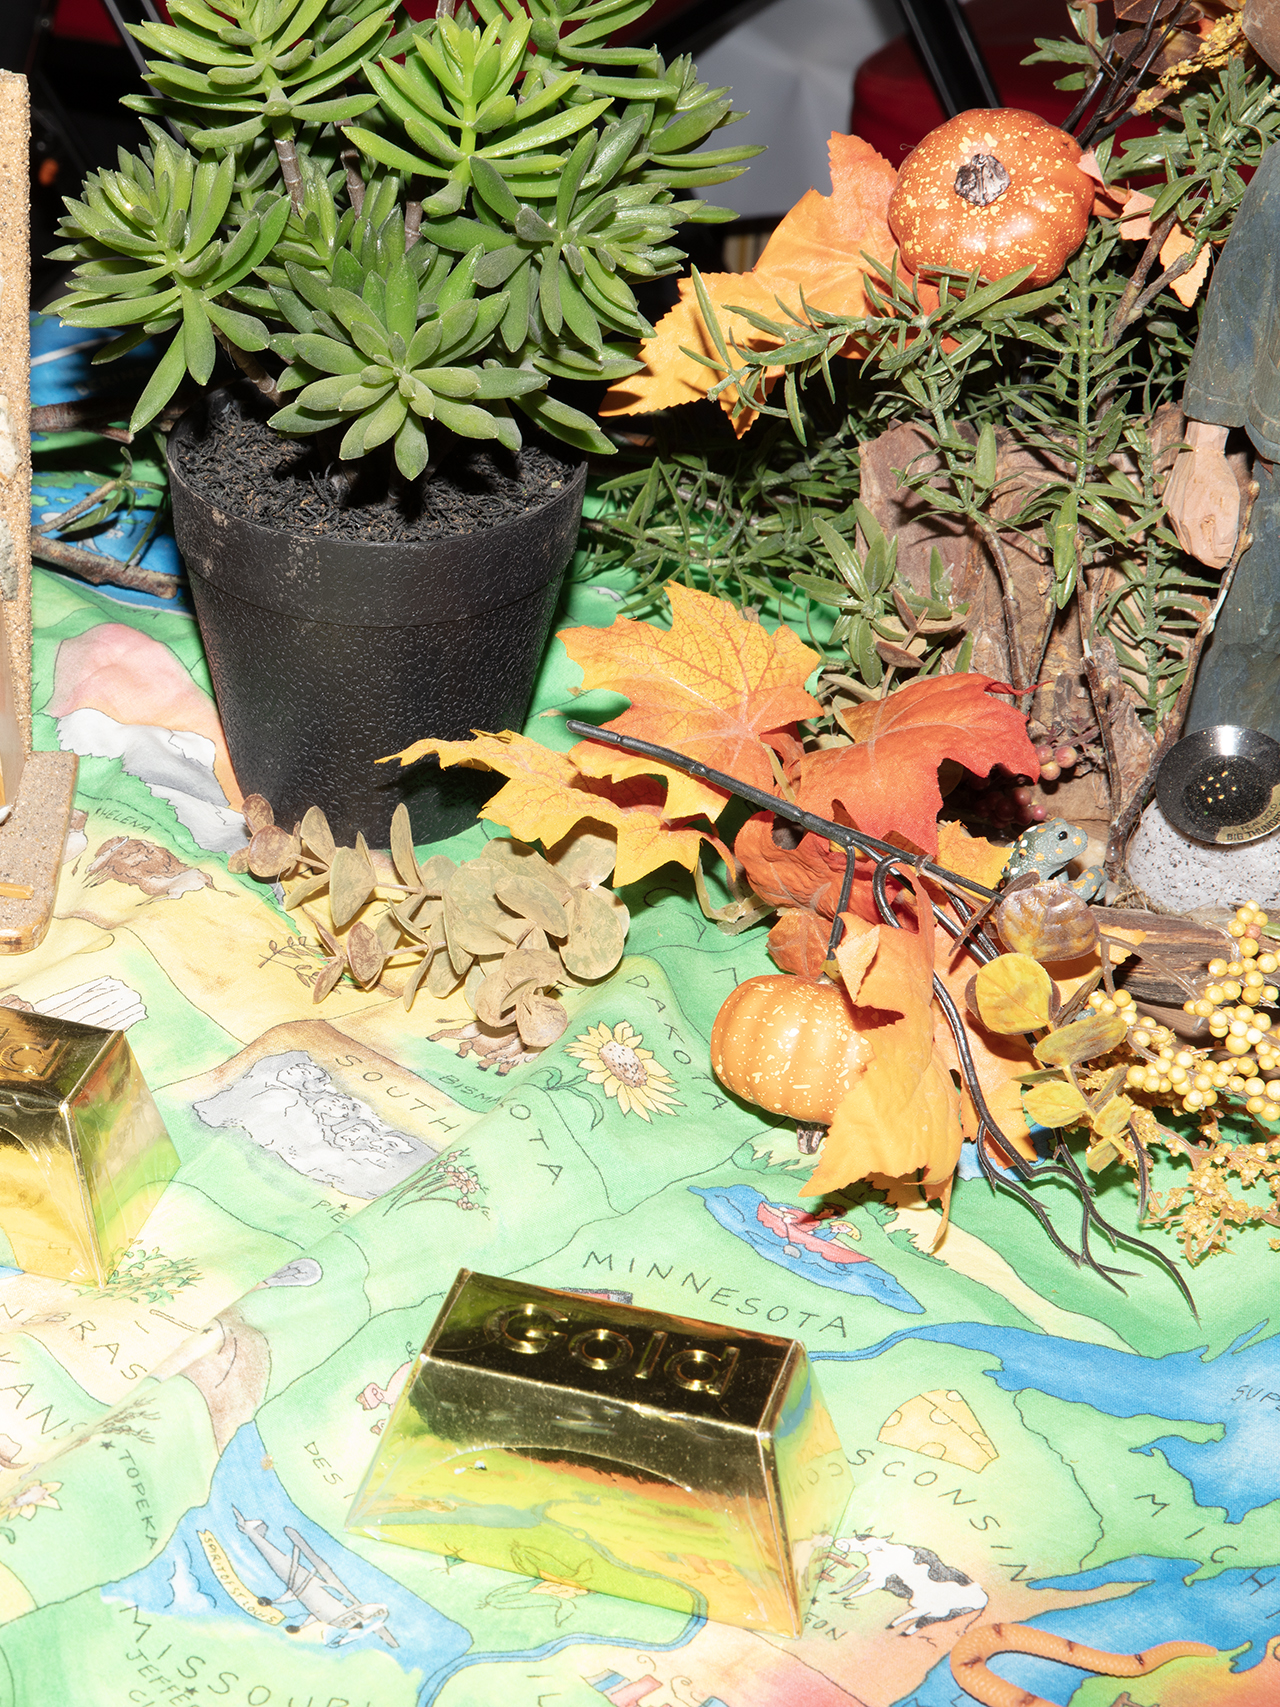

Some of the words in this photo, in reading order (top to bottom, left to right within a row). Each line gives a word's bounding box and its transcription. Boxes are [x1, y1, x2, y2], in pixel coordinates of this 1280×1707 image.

[98, 808, 152, 833] HELENA
[1226, 833, 1244, 841] BIG
[625, 975, 729, 1110] DAKOTA
[335, 1055, 460, 1133] SOUTH
[582, 1251, 847, 1337] MINNESOTA
[483, 1302, 740, 1395] Gold
[119, 1449, 158, 1550] TOPEKA
[303, 1441, 344, 1485] DES
